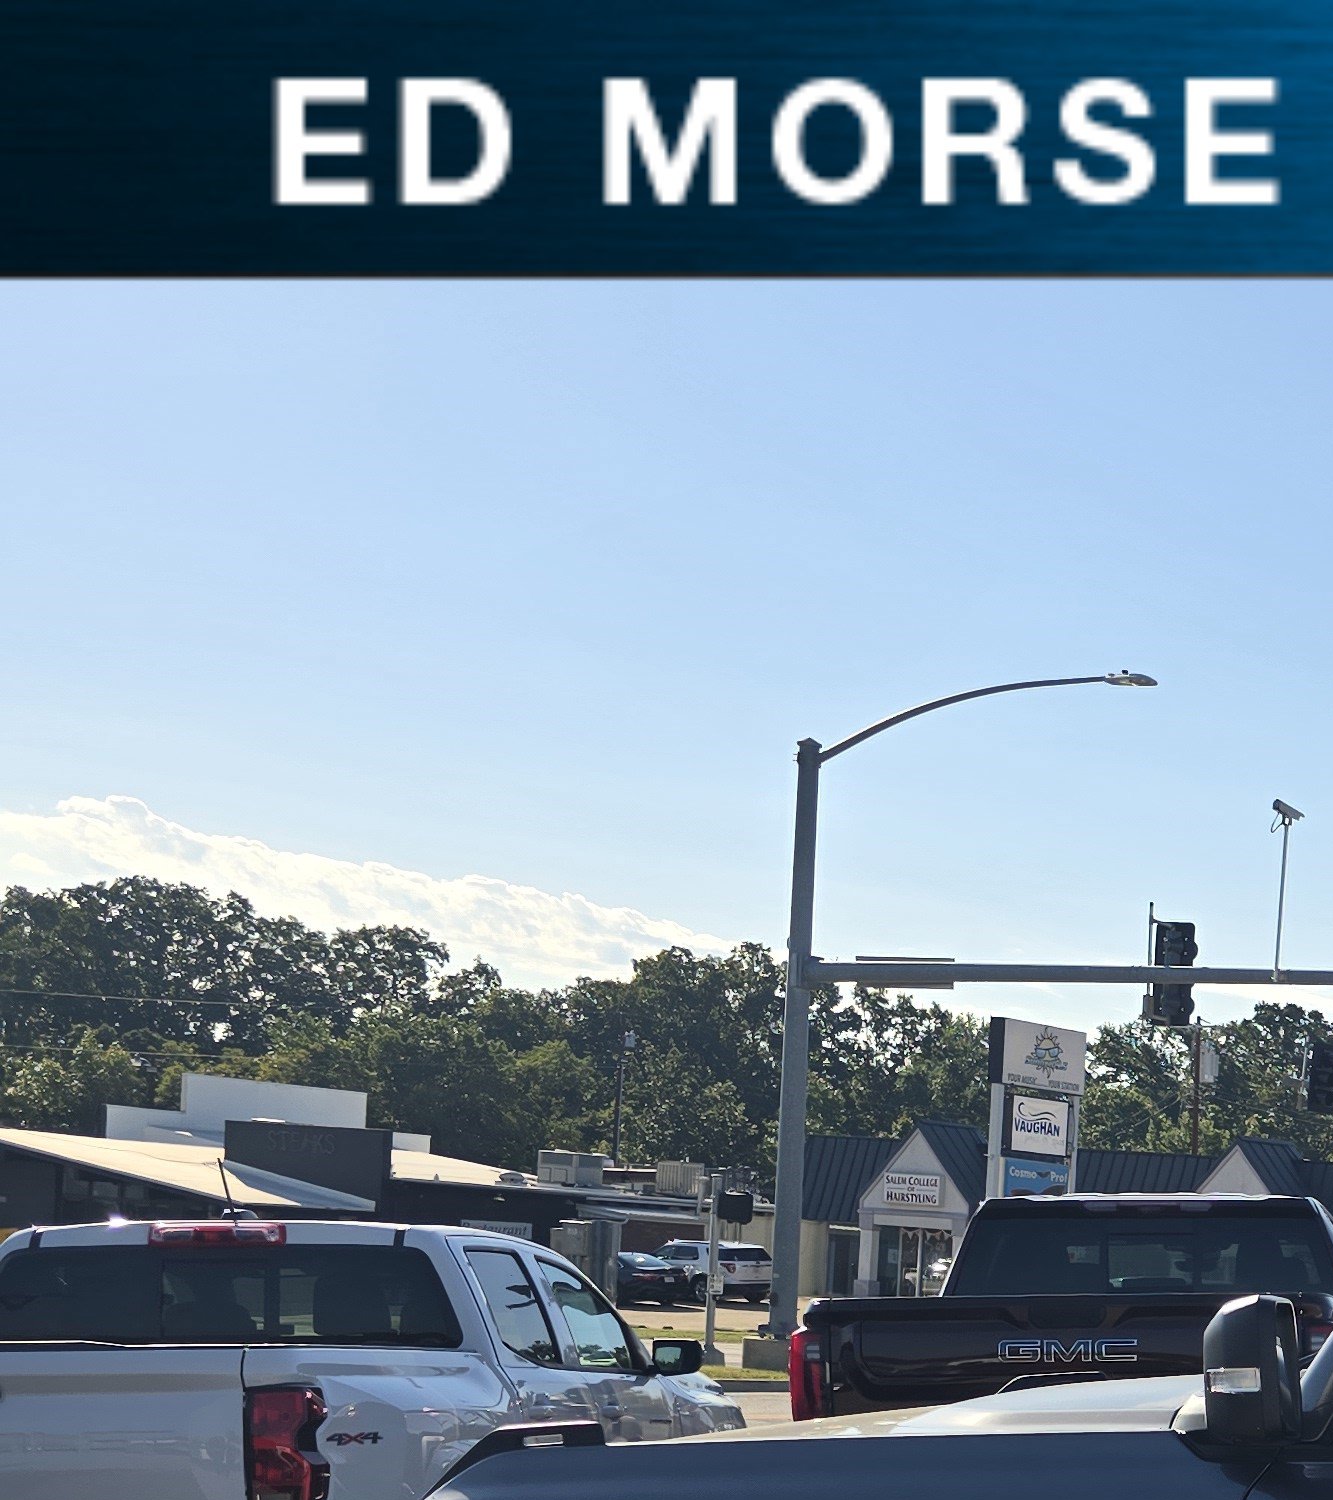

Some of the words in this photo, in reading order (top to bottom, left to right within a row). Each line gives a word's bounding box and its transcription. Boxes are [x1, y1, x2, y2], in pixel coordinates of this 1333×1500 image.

[1014, 1118, 1060, 1137] VAUGHAN
[1009, 1166, 1038, 1179] Cosmo
[885, 1175, 907, 1185] SALEM
[908, 1177, 938, 1187] COLLEGE
[886, 1191, 937, 1204] HAIRSTYLING
[998, 1339, 1138, 1363] GMC
